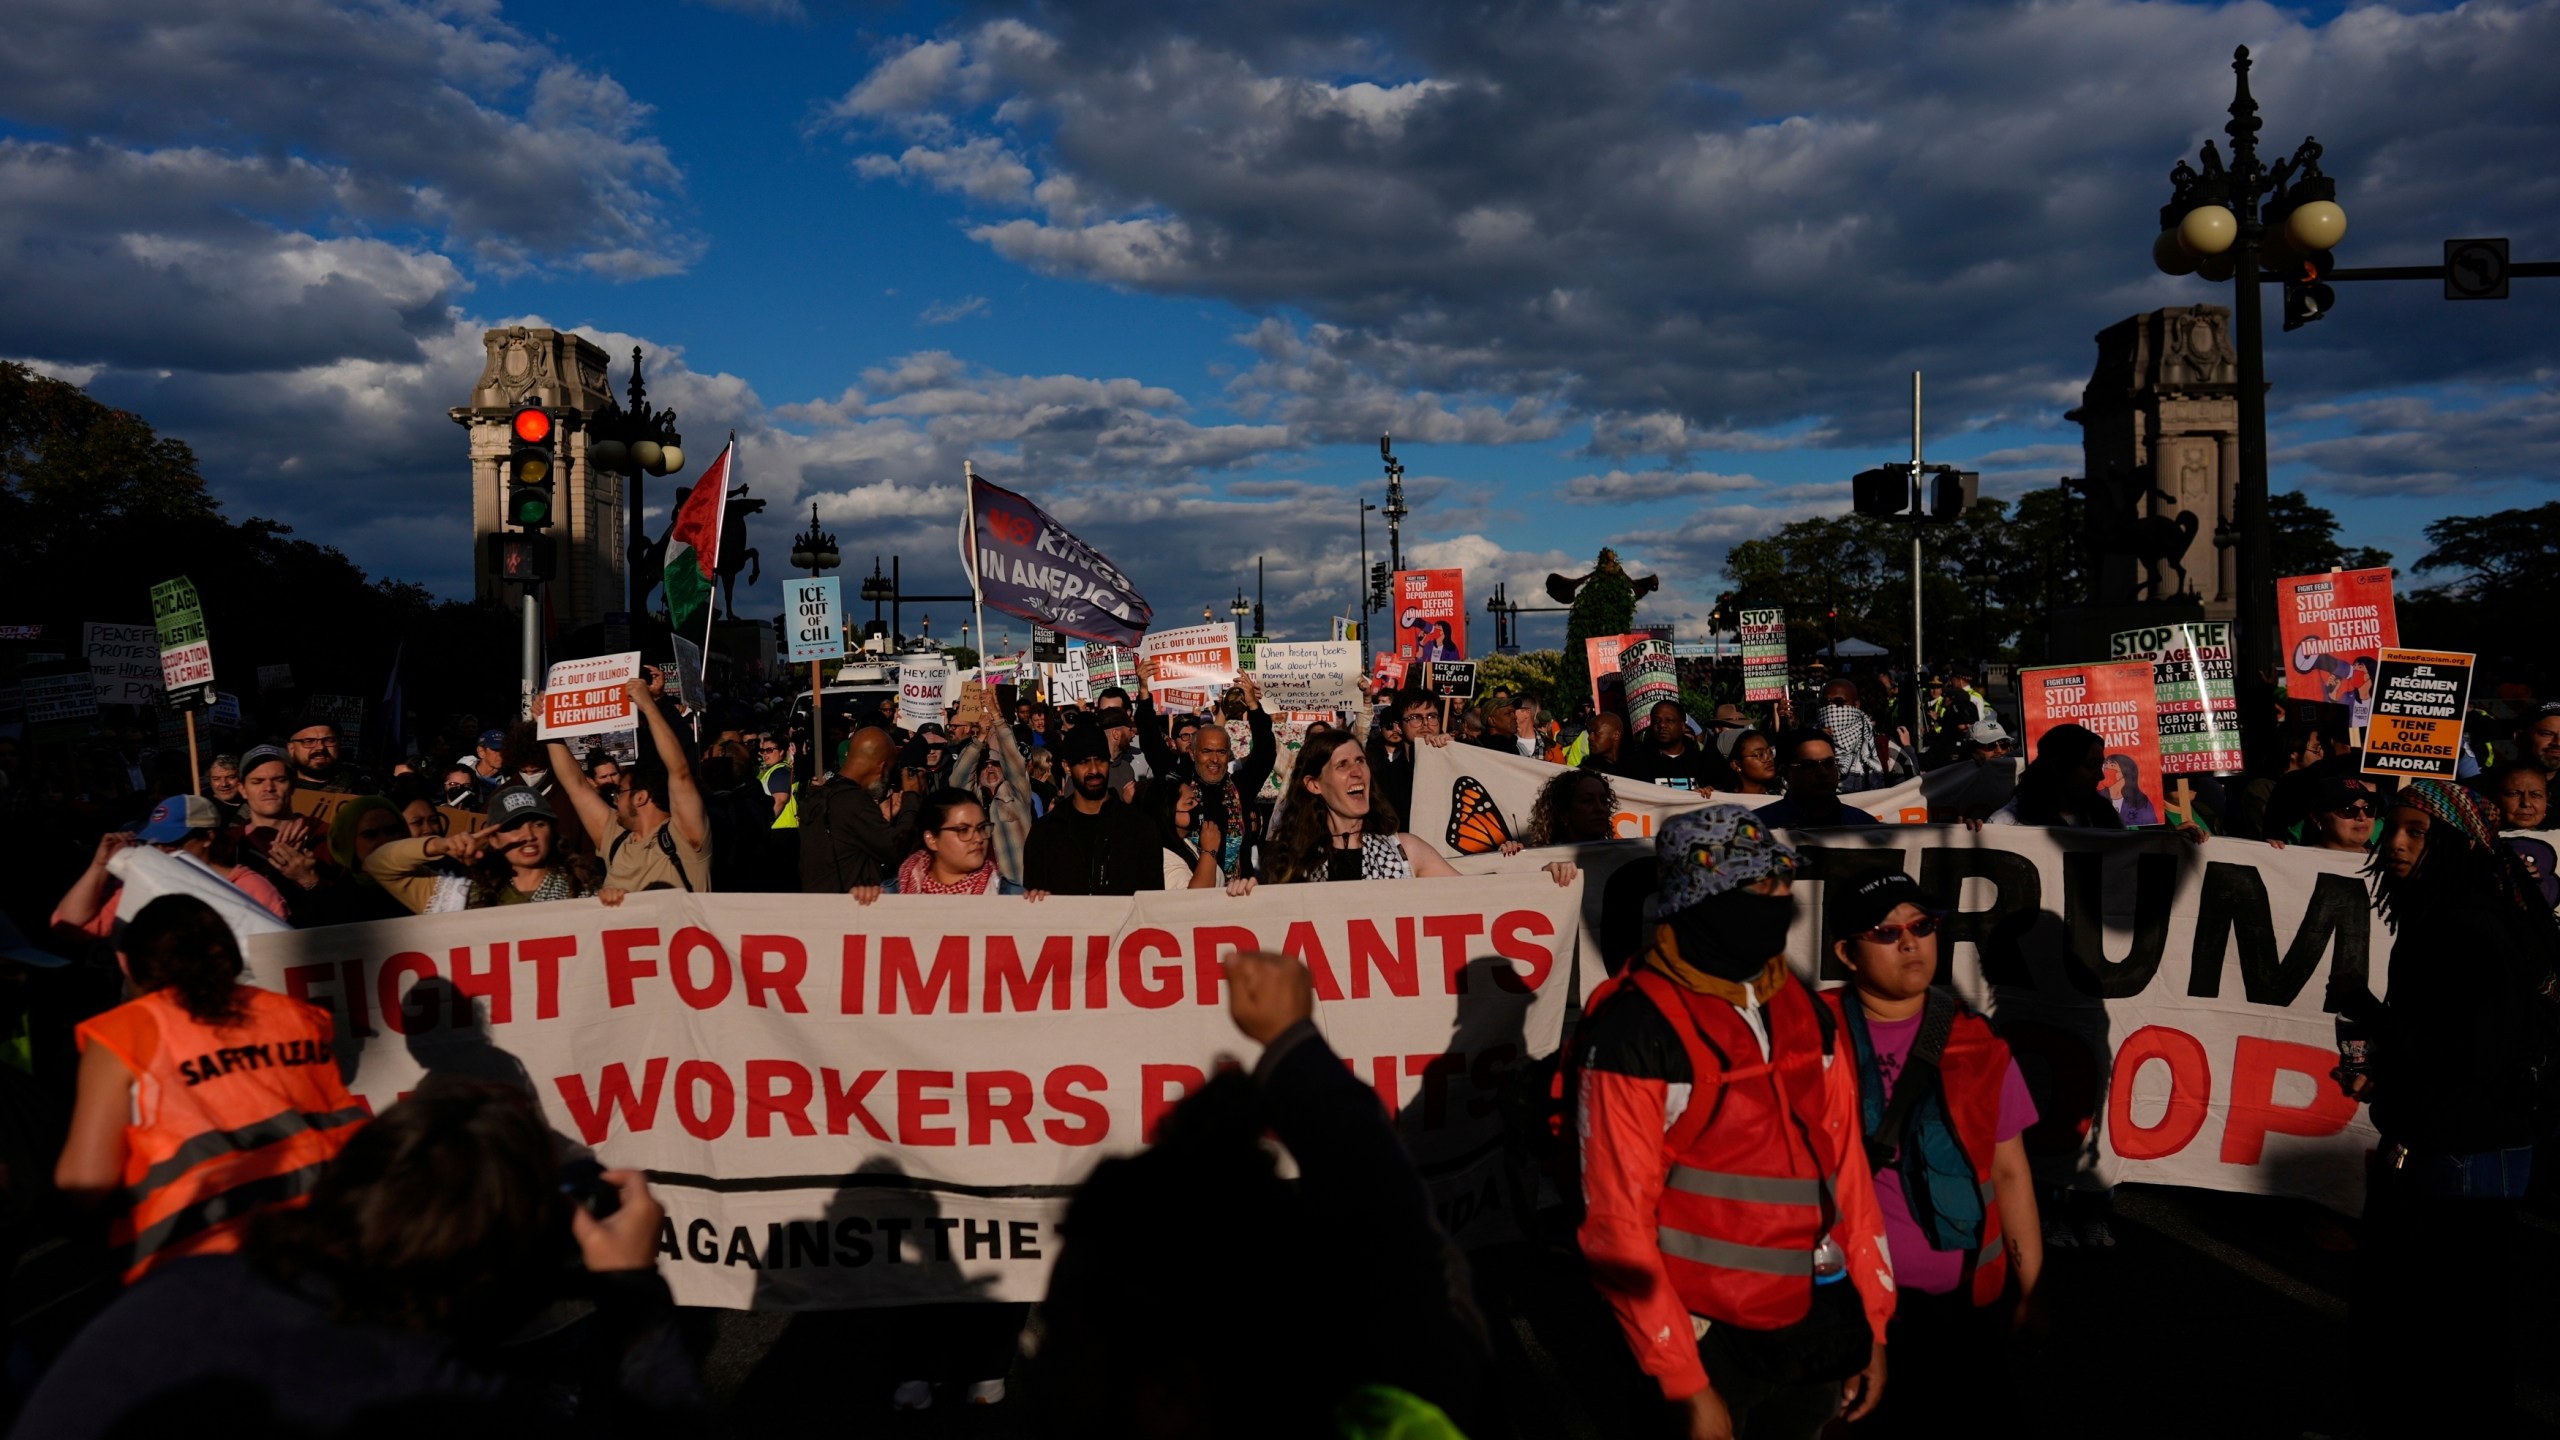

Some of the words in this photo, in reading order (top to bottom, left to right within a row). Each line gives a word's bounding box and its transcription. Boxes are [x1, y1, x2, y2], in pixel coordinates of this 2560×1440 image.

[1035, 527, 1131, 594] KINGS
[980, 547, 1007, 583] IN
[1011, 558, 1131, 622] AMERICA
[1405, 581, 1428, 592] STOP
[2297, 584, 2313, 593] FIGHT
[2314, 583, 2329, 591] FEAR
[799, 586, 826, 603] ICE
[1405, 590, 1454, 600] DEPORTATIONS
[154, 589, 198, 618] CHICAGO
[1422, 598, 1454, 609] DEFEND
[2296, 592, 2335, 612] STOP
[193, 609, 201, 619] TO
[799, 602, 829, 617] OUT
[1406, 608, 1454, 618] IMMIGRANTS
[2298, 605, 2379, 625] DEPORTATIONS
[807, 616, 823, 626] OF
[1742, 611, 1774, 626] STOP
[159, 621, 205, 648] PALESTINE
[800, 625, 830, 642] CHI
[1034, 630, 1055, 638] FASCIST
[1742, 625, 1769, 634] TRUMP
[2328, 618, 2380, 638] DEFEND
[1150, 643, 1168, 651] I.C.E.
[1169, 640, 1184, 648] OUT
[1186, 638, 1195, 646] OF
[1197, 634, 1229, 645] ILLINOIS
[1742, 633, 1769, 641] DEFEND
[2112, 628, 2172, 656] STOP
[2179, 623, 2225, 648] THE
[88, 643, 160, 659] PROTES
[1598, 647, 1618, 657] STOP
[2301, 635, 2383, 656] IMMIGRANTS
[162, 646, 209, 670] OCCUPATION
[1159, 655, 1184, 667] I.C.E.
[1187, 651, 1207, 664] OUT
[1208, 649, 1222, 662] OF
[1260, 646, 1285, 658] When
[1288, 645, 1318, 664] history
[1322, 645, 1347, 656] books
[1620, 643, 1647, 667] STOP
[1650, 641, 1672, 656] THE
[1643, 653, 1674, 663] AGENDA!
[91, 665, 116, 675] THE
[119, 663, 163, 677] HIDEO
[1264, 659, 1283, 670] talk
[1287, 660, 1313, 670] about
[1318, 658, 1337, 669] this
[1434, 663, 1449, 671] ICE
[1653, 661, 1676, 670] EXPAND
[2166, 664, 2174, 674] &
[182, 662, 211, 683] CRIME!
[568, 673, 585, 685] OUT
[586, 671, 597, 683] OF
[598, 666, 630, 680] ILLINOIS
[903, 669, 927, 679] HEY,
[929, 669, 946, 678] ICE!
[2188, 669, 2234, 681] RGHTS
[2412, 665, 2436, 678] ¡EL
[1262, 671, 1297, 680] moment,
[1311, 672, 1326, 680] can
[1328, 672, 1344, 687] say
[1282, 680, 1311, 688] tried!
[2046, 678, 2064, 686] FIGHT
[2065, 676, 2081, 685] FEAR
[2390, 675, 2458, 691] RÉGIMEN
[25, 683, 92, 697] REFERENDUM
[95, 684, 114, 696] OF
[903, 683, 919, 697] GO
[920, 684, 944, 698] BACK
[1638, 683, 1660, 693] POLICE
[2179, 680, 2233, 693] PALSTINE
[553, 692, 582, 709] I.C.E.
[584, 689, 606, 706] OUT
[608, 686, 622, 702] OF
[1168, 689, 1181, 697] I.C.E.
[1181, 691, 1192, 699] OUT
[1264, 690, 1282, 699] Our
[1746, 694, 1777, 702] ACADEMIC
[2045, 687, 2087, 706] STOP
[2156, 693, 2174, 703] AID
[2179, 692, 2193, 701] TO
[2384, 689, 2455, 705] FASCISTA
[59, 698, 95, 709] POLICE
[961, 704, 980, 713] Fuck
[1167, 696, 1201, 707] EVERYWHERE
[2156, 702, 2189, 713] OLICE
[2194, 699, 2236, 711] CIMES
[552, 703, 623, 725] EVERYWHERE
[2046, 700, 2138, 720] DEPORTATIONS
[2215, 711, 2238, 721] AND
[2380, 702, 2402, 714] DE
[2403, 704, 2456, 717] TRUMP
[2079, 714, 2139, 734] DEFEND
[2391, 719, 2437, 732] TIENE
[2159, 733, 2193, 745] ORKERS'
[2228, 731, 2240, 741] TO
[2397, 731, 2431, 742] QUE
[2181, 743, 2190, 752] &
[2371, 741, 2453, 756] LARGARSE
[2164, 751, 2230, 764] EDUCATION
[2233, 750, 2242, 760] &
[2376, 756, 2441, 771] AHORA!
[2186, 759, 2243, 772] FREEDOM
[1795, 844, 2372, 1014] TRUM
[284, 934, 578, 1038] FIGHT
[602, 925, 809, 1014] FOR
[840, 909, 1555, 1015] IMMIGRANTS
[555, 1056, 1110, 1147] WORKERS
[655, 1217, 912, 1270] AGAINST
[924, 1217, 1042, 1261] THE
